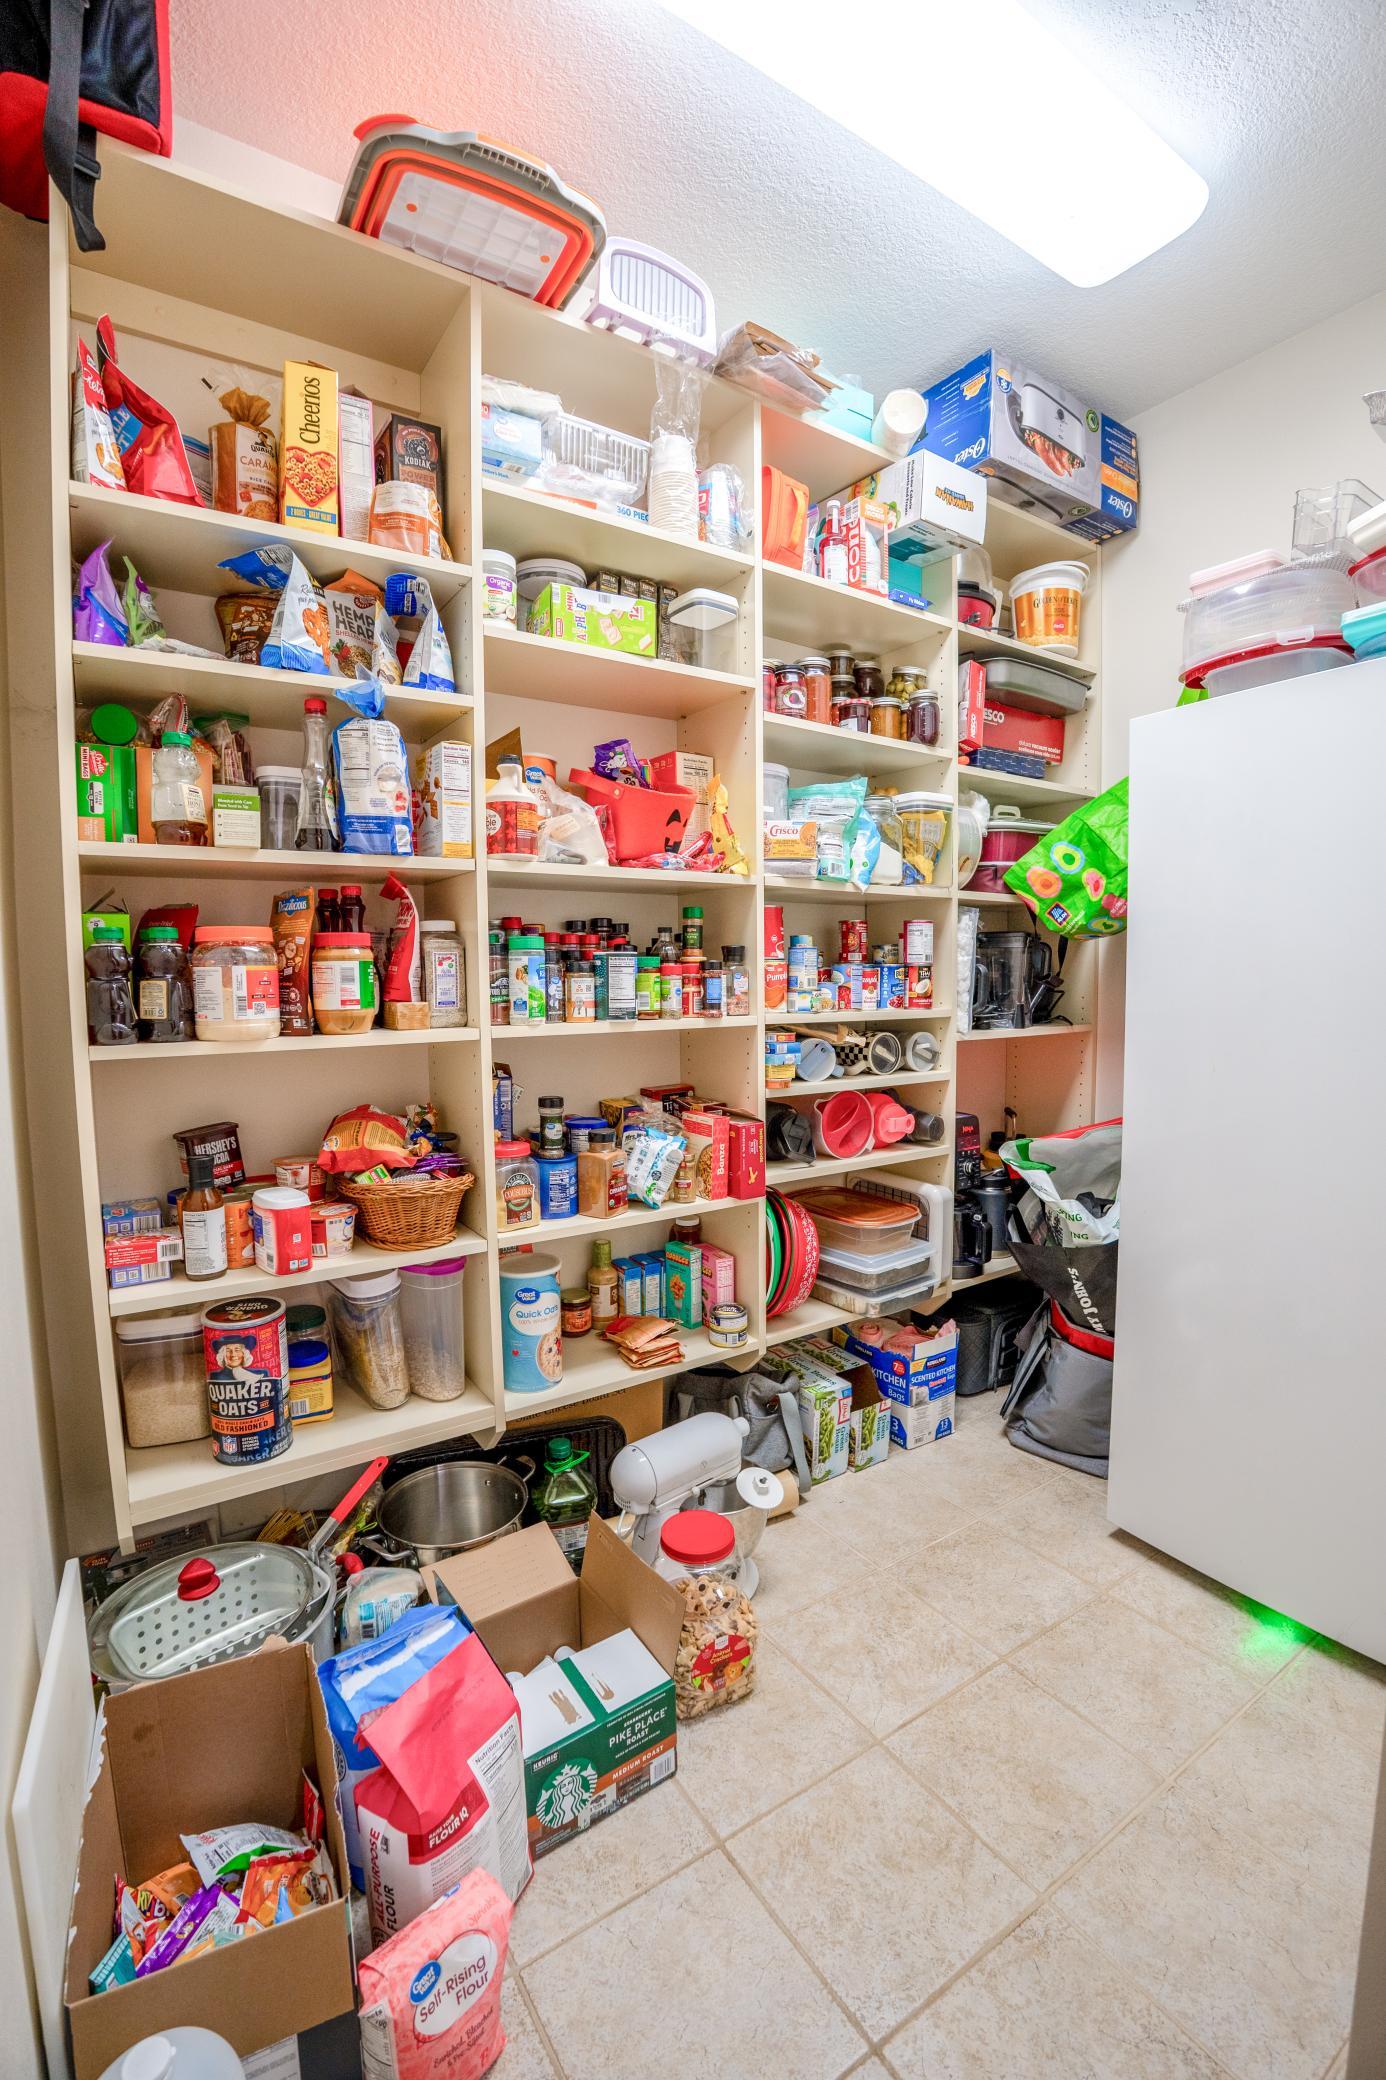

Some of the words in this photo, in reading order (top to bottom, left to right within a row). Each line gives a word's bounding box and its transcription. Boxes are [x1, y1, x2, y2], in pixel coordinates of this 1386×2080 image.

[300, 376, 321, 446] Cheerios
[953, 437, 986, 464] Oster
[240, 454, 277, 474] CARAM
[403, 455, 433, 471] KODIAK
[935, 486, 975, 513] HAWAIIAN
[1107, 494, 1134, 519] Oster
[617, 504, 632, 517] 360
[633, 509, 650, 522] PIEC
[489, 576, 513, 589] Organic
[332, 600, 376, 628] HEMP
[335, 616, 375, 641] HEAR
[983, 708, 1006, 724] ESCO
[1057, 912, 1068, 924] ALDI
[766, 970, 788, 983] Pump
[193, 1136, 237, 1155] HERSHEY'S
[212, 1152, 230, 1165] COA
[716, 1143, 726, 1176] Banza
[504, 1187, 533, 1199] COUSCOUS
[1070, 1231, 1089, 1240] ING
[517, 1290, 536, 1299] Great
[1067, 1267, 1100, 1317] JOHN'S
[225, 1304, 268, 1312] QUAKER
[515, 1308, 541, 1319] Quick
[827, 1348, 851, 1365] Green
[926, 1356, 946, 1367] KIRKLAND
[786, 1356, 812, 1376] Green
[810, 1369, 838, 1387] Beans
[892, 1363, 899, 1371] 7
[911, 1372, 935, 1384] SCENTED
[936, 1364, 956, 1377] KITCHEN
[871, 1367, 907, 1389] KITCHEN
[208, 1382, 275, 1402] QUAKER
[888, 1388, 905, 1402] Bags
[218, 1399, 258, 1416] OATS
[214, 1422, 225, 1434] OLD
[224, 1419, 269, 1433] FASHIONED
[891, 1419, 899, 1430] 3
[940, 1419, 949, 1428] 13
[223, 1442, 237, 1453] NFL
[890, 1434, 905, 1446] BAGS
[709, 1652, 733, 1665] Crackers
[711, 1647, 731, 1658] Animal
[623, 1708, 653, 1728] STARBUCKS
[609, 1727, 632, 1748] PIKE
[634, 1709, 667, 1733] PLACE
[626, 1728, 649, 1746] ROAST
[474, 1739, 501, 1765] Nutrition
[499, 1723, 514, 1741] Facts
[533, 1752, 559, 1769] KEURIG
[612, 1759, 641, 1780] MEDIUM
[642, 1745, 664, 1762] ROAST
[428, 1822, 444, 1840] RAISE
[429, 1817, 460, 1849] FLOUR
[459, 1806, 470, 1822] IQ
[369, 1827, 384, 1926] ALL-PURPOSE
[384, 1884, 398, 1933] FLOUR
[413, 1966, 435, 1994] Great
[419, 1955, 487, 2023] Self-Rising
[455, 1970, 490, 2006] Flour
[465, 2006, 494, 2039] Bleached
